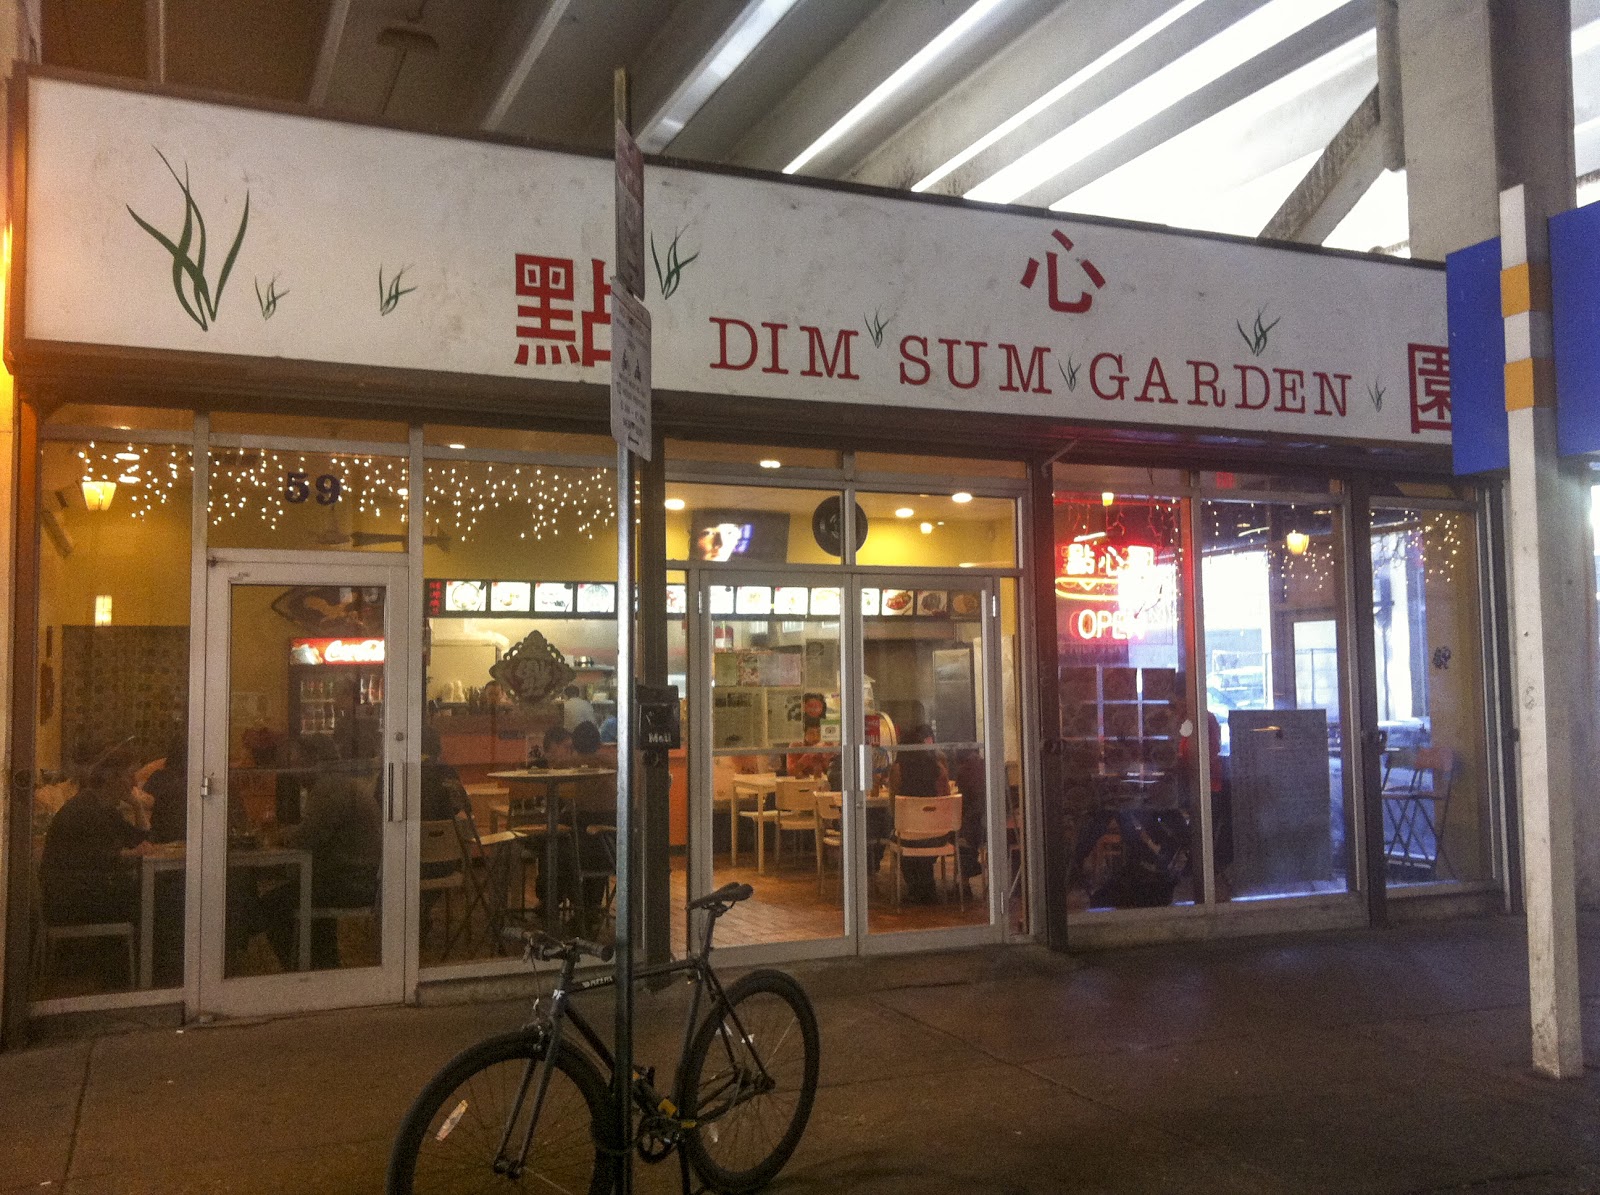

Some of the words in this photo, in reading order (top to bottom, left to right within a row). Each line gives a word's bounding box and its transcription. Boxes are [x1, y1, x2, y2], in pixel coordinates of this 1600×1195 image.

[514, 252, 612, 367] 點
[1019, 228, 1107, 314] 心
[708, 316, 860, 381] DIM
[899, 334, 1052, 395] SUM
[1088, 352, 1352, 418] GARDEN
[284, 470, 341, 506] 59
[1066, 543, 1154, 577] 點心
